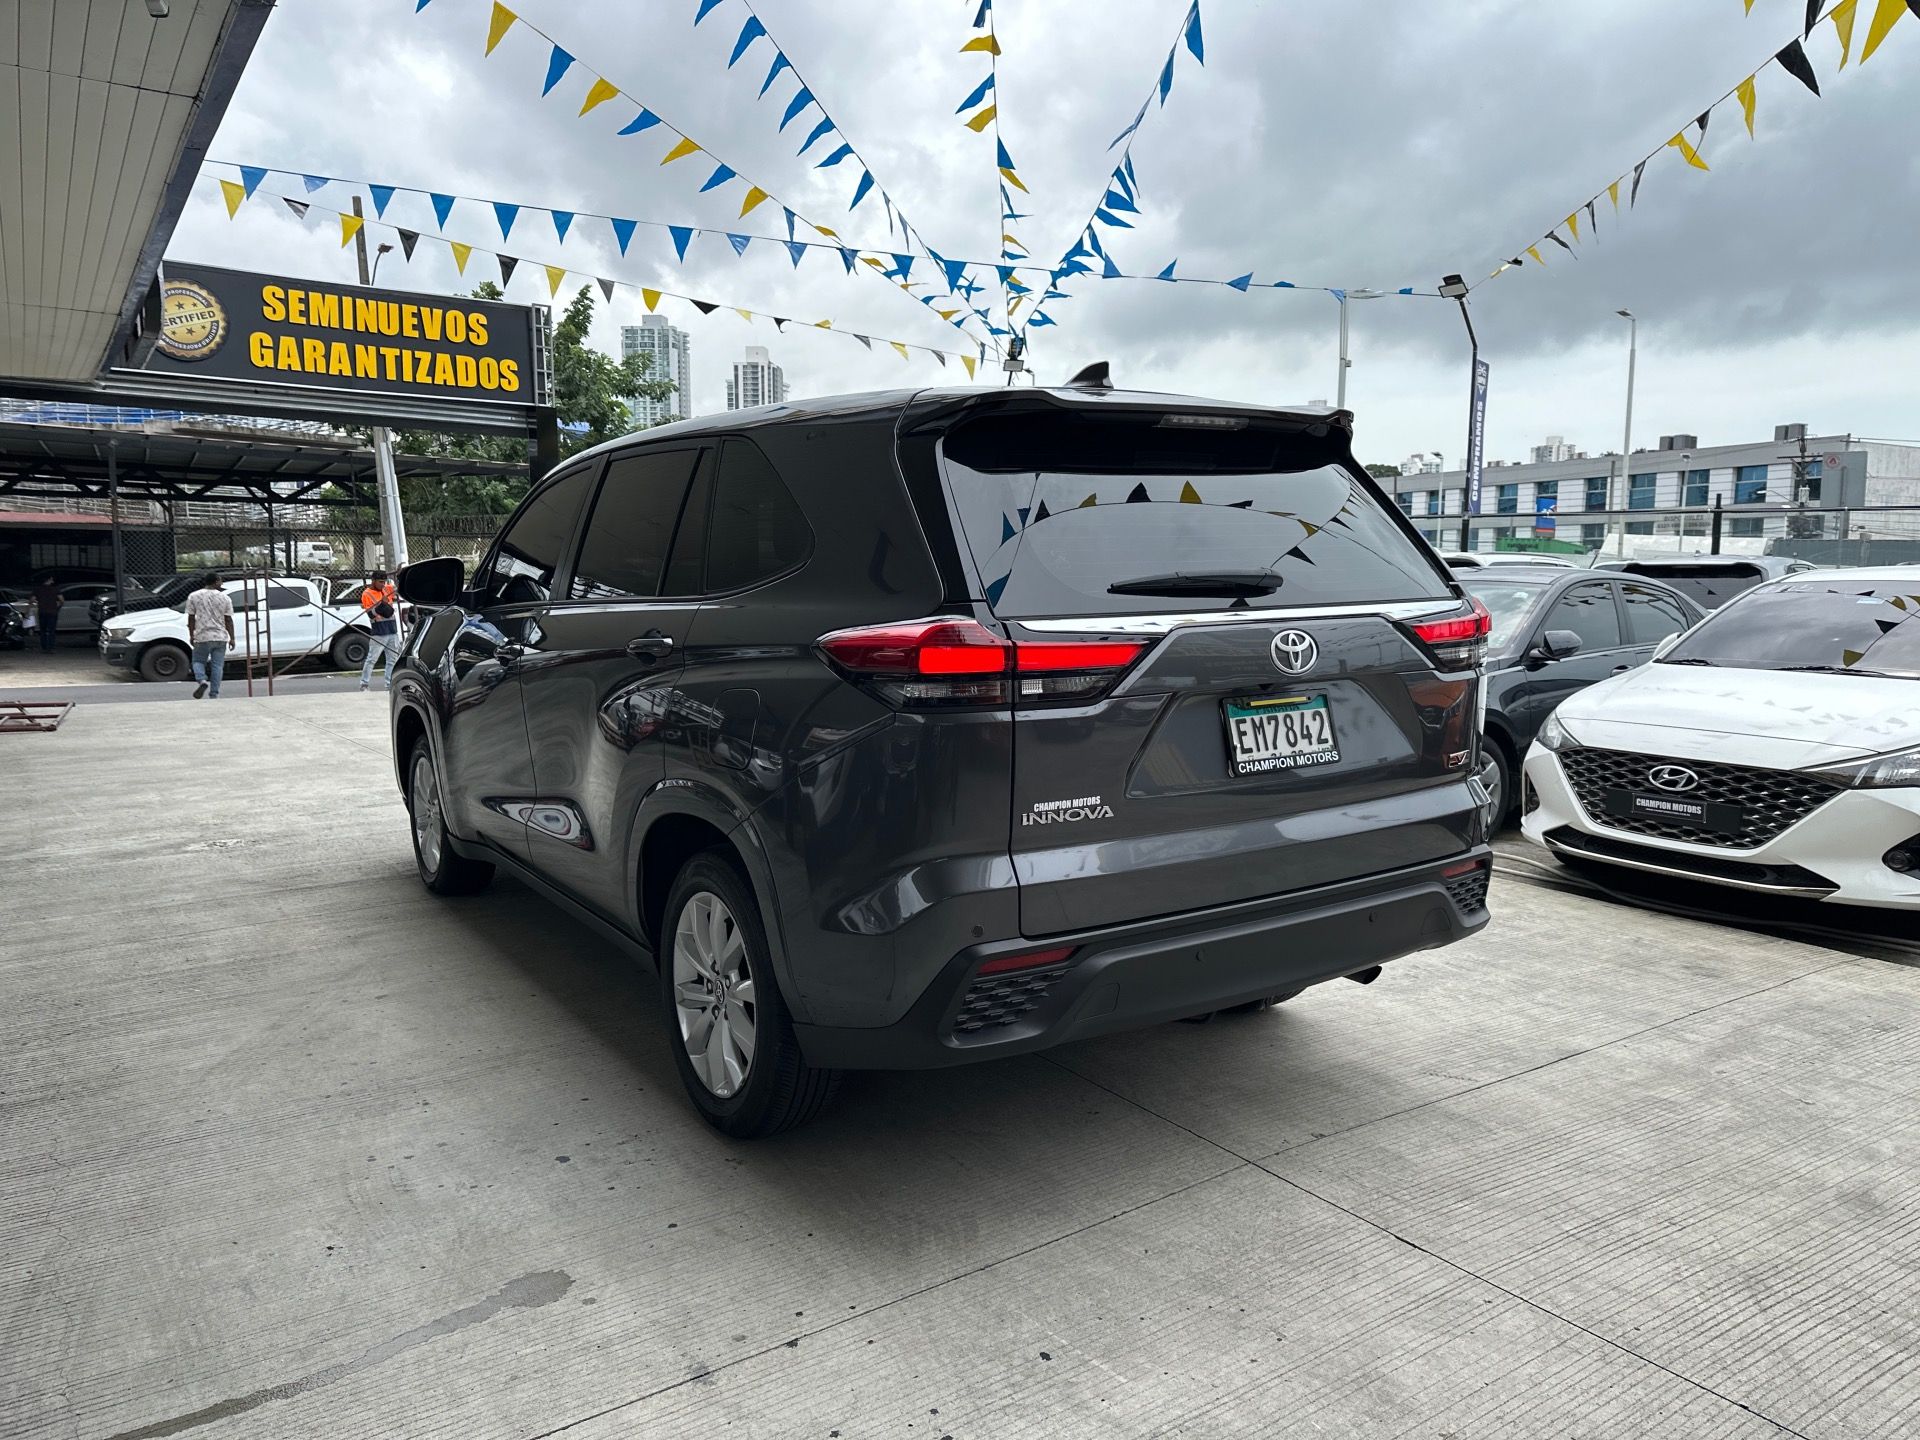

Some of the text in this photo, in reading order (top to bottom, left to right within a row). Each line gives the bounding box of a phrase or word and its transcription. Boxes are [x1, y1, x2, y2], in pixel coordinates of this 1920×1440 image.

[163, 310, 217, 327] ERTIFIED
[262, 285, 489, 346] SEMINUEVOS
[249, 331, 519, 392] GARANTIZADOS
[1472, 401, 1483, 502] COMPRAMOS
[1235, 710, 1329, 754] EM7842
[1238, 756, 1294, 773] CHAMPION
[1296, 751, 1339, 766] MOTORS
[1033, 795, 1101, 812] CHAMPION MOTORS
[1636, 798, 1671, 810] CHAMPION
[1672, 803, 1702, 814] MOTORS
[1022, 805, 1114, 826] INNOVA
